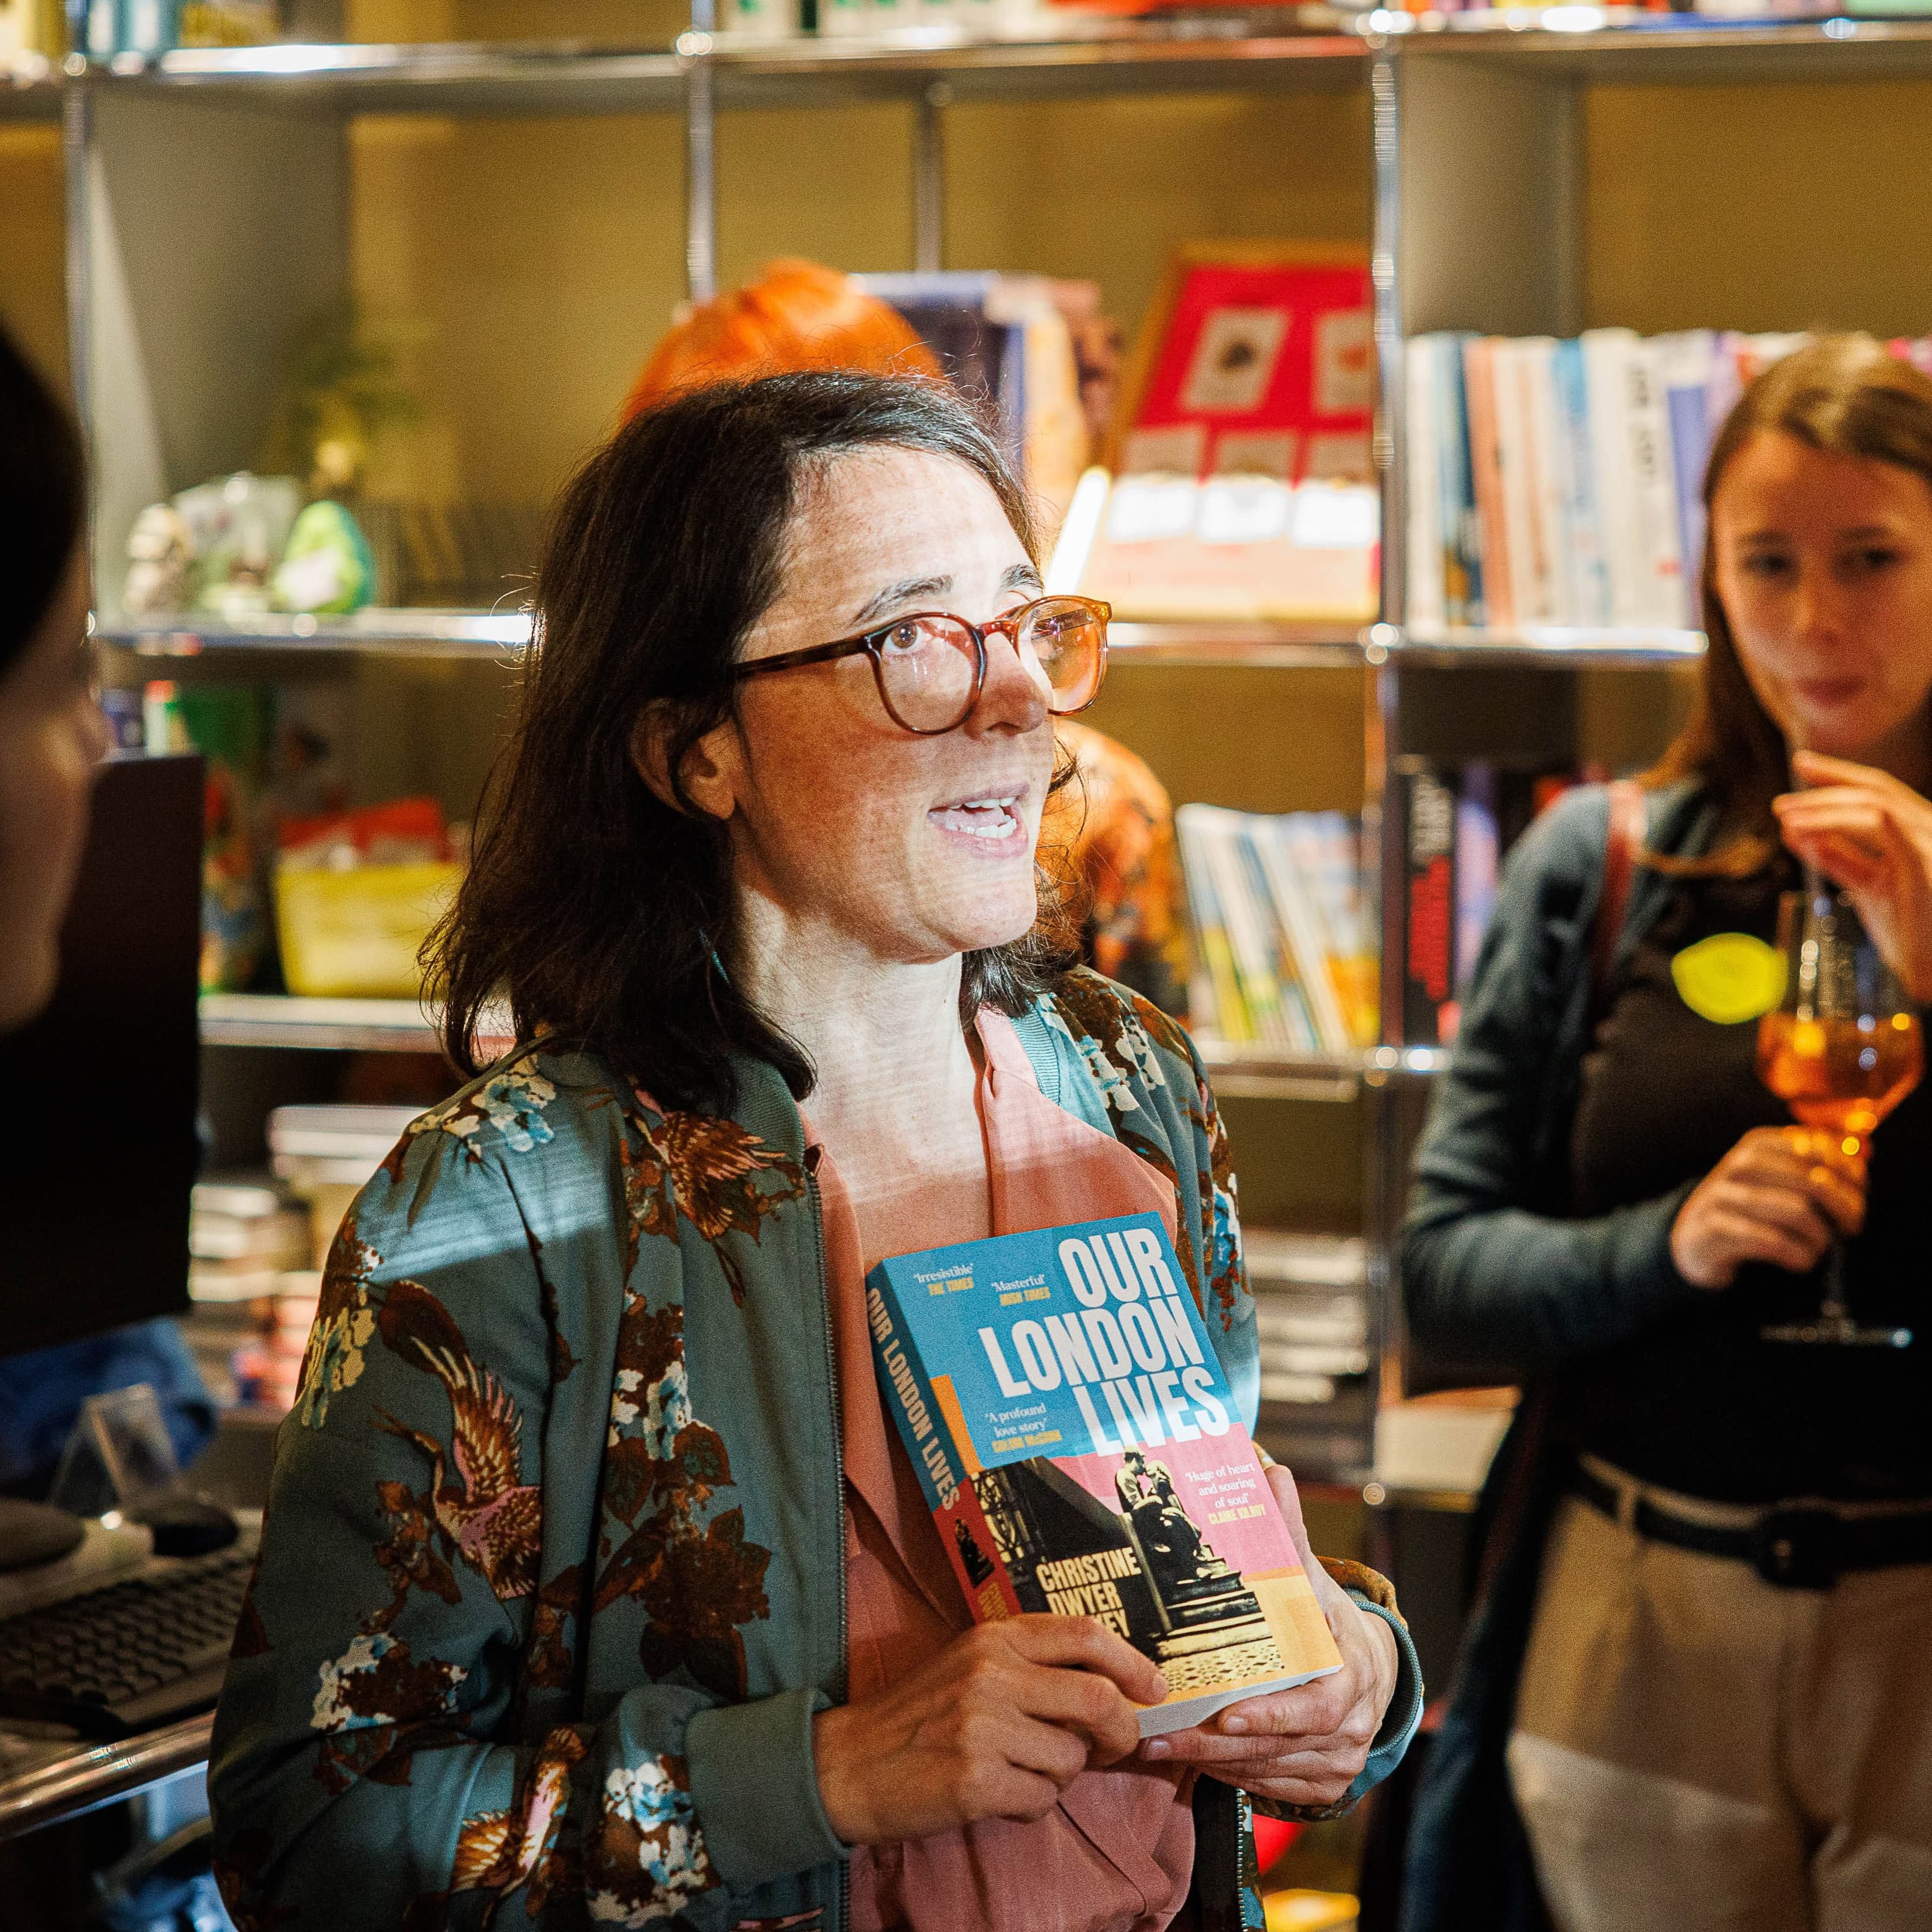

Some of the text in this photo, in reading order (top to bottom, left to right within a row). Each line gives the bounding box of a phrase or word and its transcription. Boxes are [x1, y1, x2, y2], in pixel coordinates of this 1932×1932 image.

[1059, 1228, 1178, 1308] OUR
[978, 1296, 1204, 1398] LONDON
[867, 1287, 960, 1510] OUR LONDON LIVES
[999, 1402, 1046, 1424] profound
[1072, 1366, 1229, 1457] LIVES
[994, 1426, 1017, 1437] love
[1216, 1466, 1227, 1477] of
[1227, 1463, 1255, 1475] heart
[1198, 1478, 1256, 1496] and soaring
[1215, 1497, 1225, 1508] of
[1237, 1503, 1266, 1519] KILROY
[1036, 1546, 1141, 1592] CHRISTINE
[1046, 1580, 1123, 1617] DWYER
